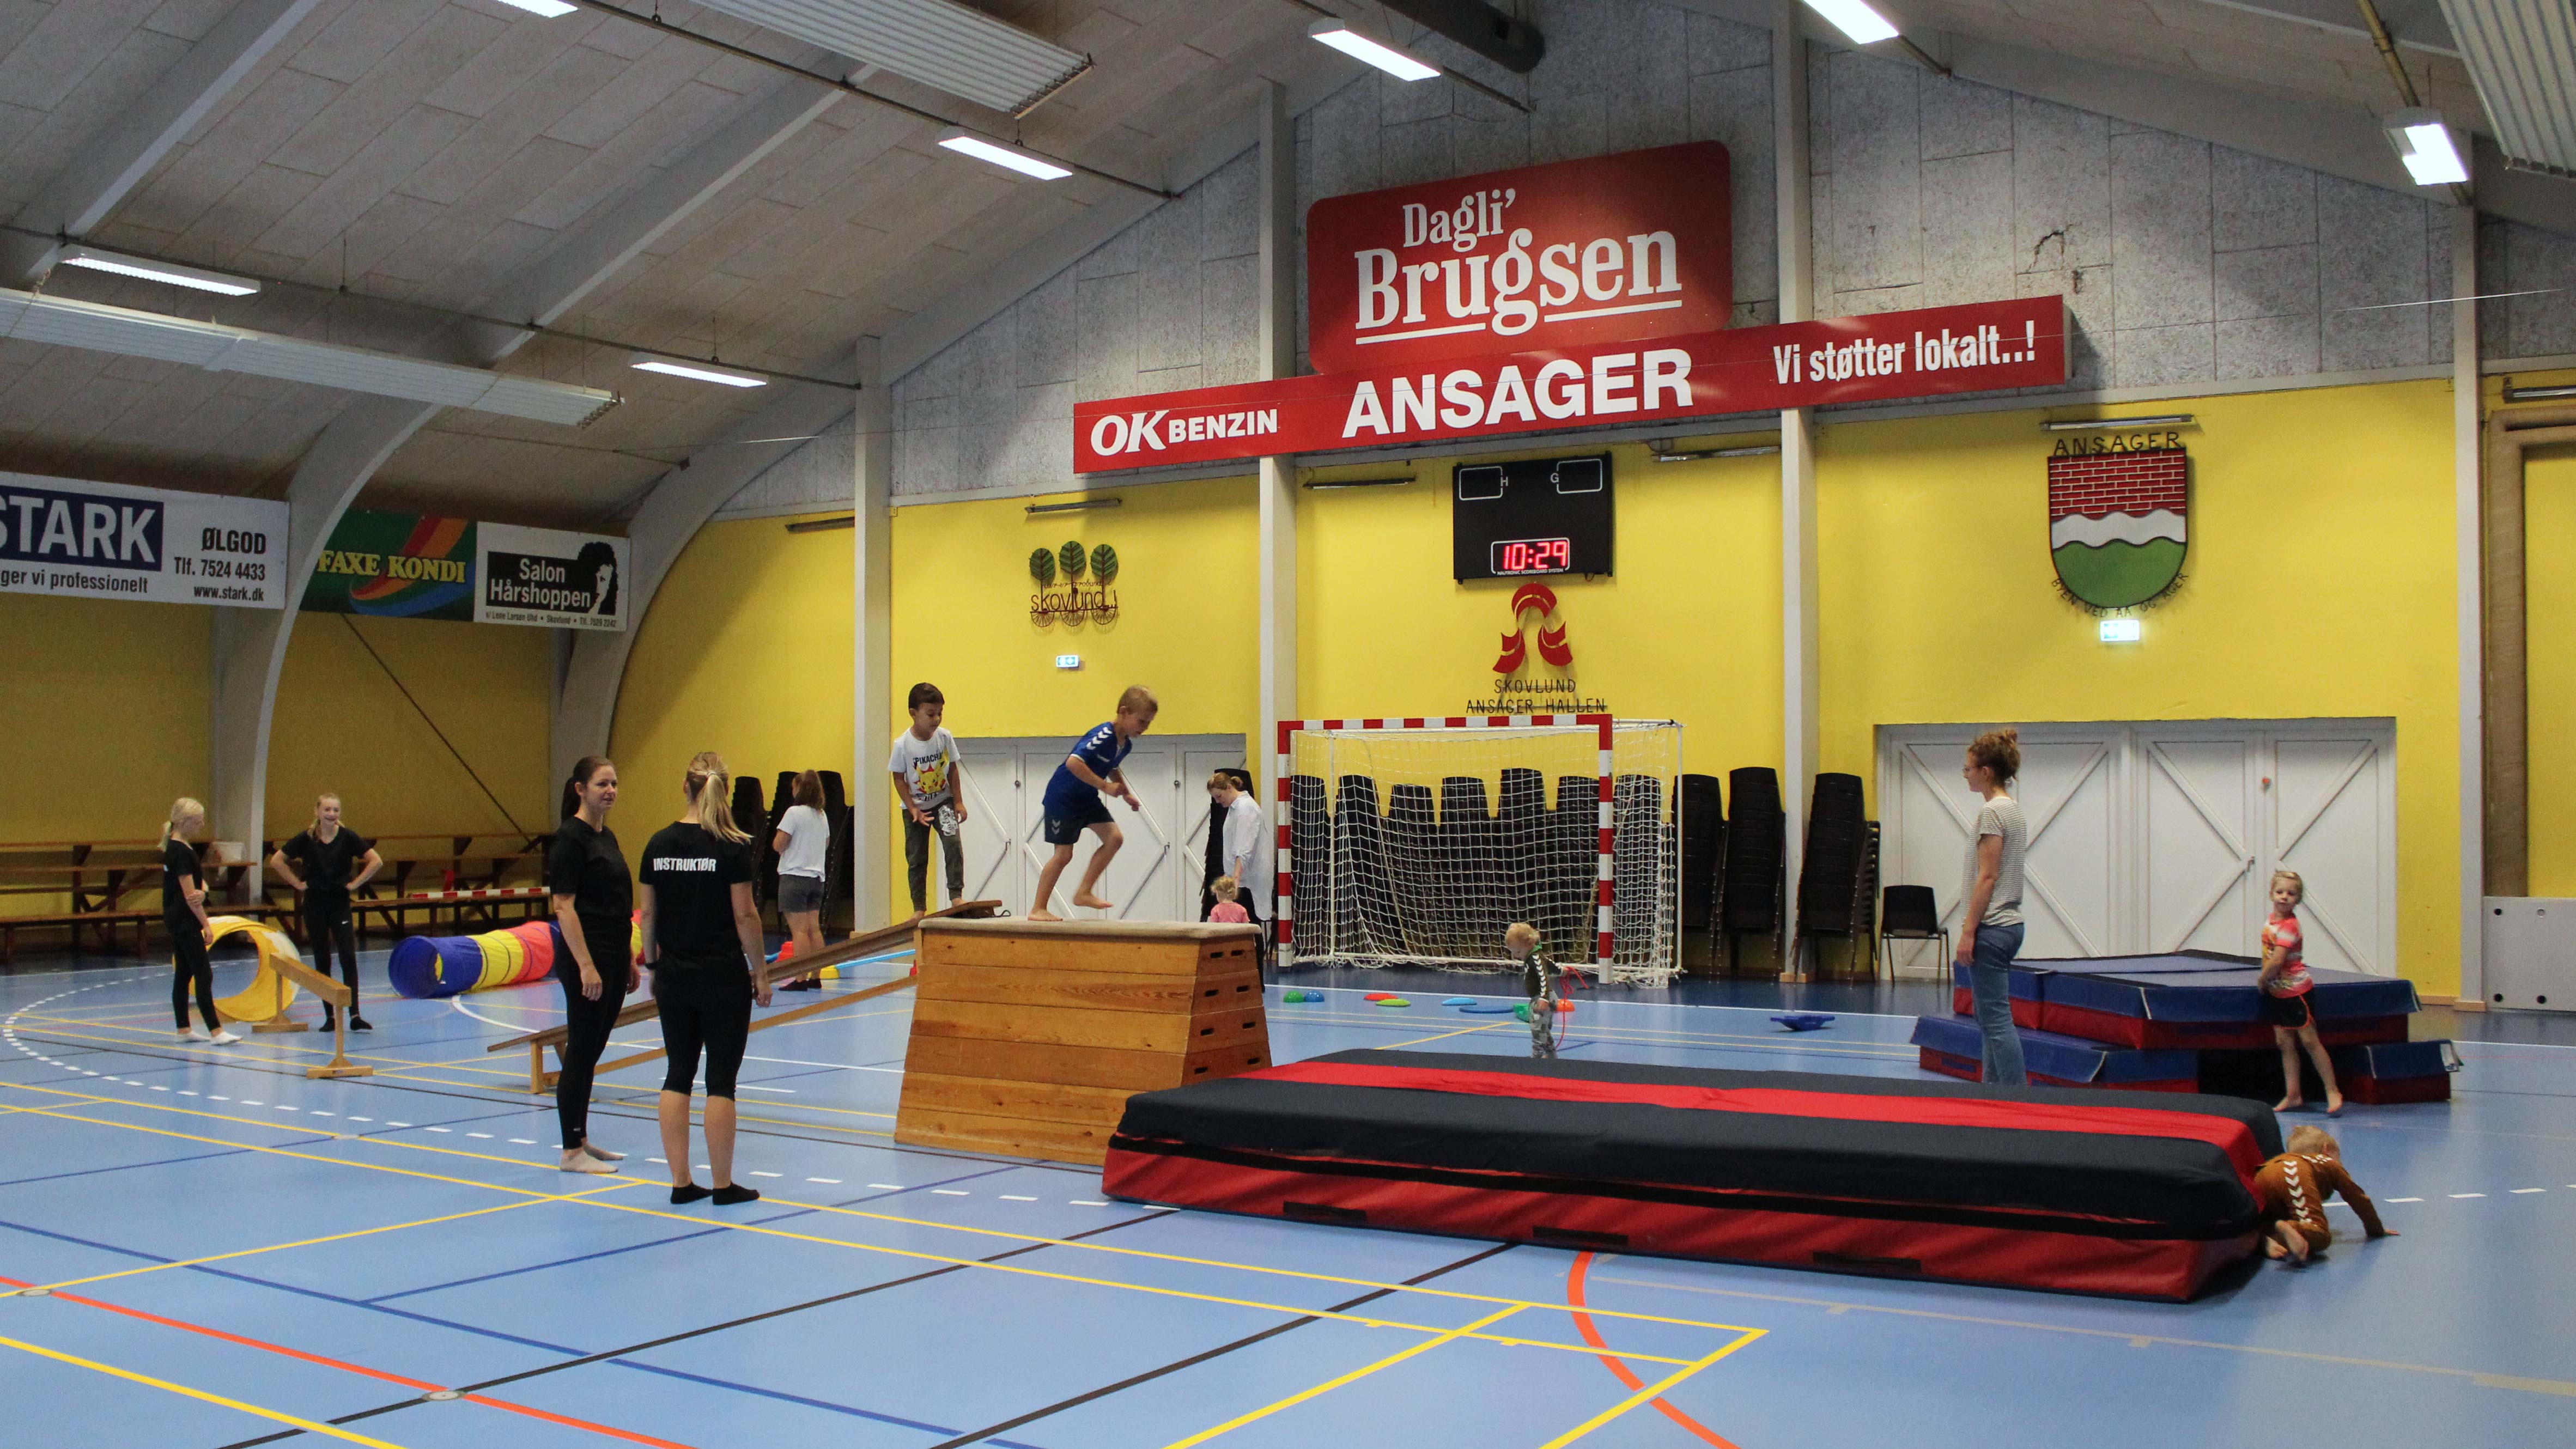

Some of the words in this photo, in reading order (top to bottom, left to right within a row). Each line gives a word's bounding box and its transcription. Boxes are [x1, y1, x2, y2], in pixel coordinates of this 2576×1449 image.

[1354, 227, 1682, 336] Brugsen
[1773, 343, 1801, 385] Vi
[1809, 337, 1906, 382] støtter
[1914, 320, 2036, 373] lokalt..!
[1341, 348, 1694, 439] ANSAGER
[1090, 409, 1170, 456] OK
[1168, 408, 1278, 444] BENZIN
[2053, 431, 2183, 456] ANSAGER
[1500, 476, 1509, 488] H
[1550, 472, 1560, 484] G
[0, 495, 156, 563] TARK
[201, 527, 266, 555] ØLGOD
[317, 550, 380, 577] FAXE
[387, 556, 466, 583] KONDI
[1503, 540, 1568, 570] 10:29
[32, 569, 45, 586] vi
[50, 573, 148, 594] professionelt
[174, 556, 195, 576] Tlf.
[201, 559, 231, 578] 7524
[235, 562, 265, 582] 4433
[519, 558, 566, 584] Salon
[193, 586, 264, 602] www.stark.dk
[490, 578, 591, 610] Hårshoppen
[2083, 601, 2108, 618] VED
[2162, 572, 2189, 600] AGER
[1494, 678, 1576, 694] SKOVLUND
[1466, 698, 1534, 714] ANSAGER
[1545, 698, 1605, 713] HALLEN
[653, 857, 716, 872] INSTRUKTØR
